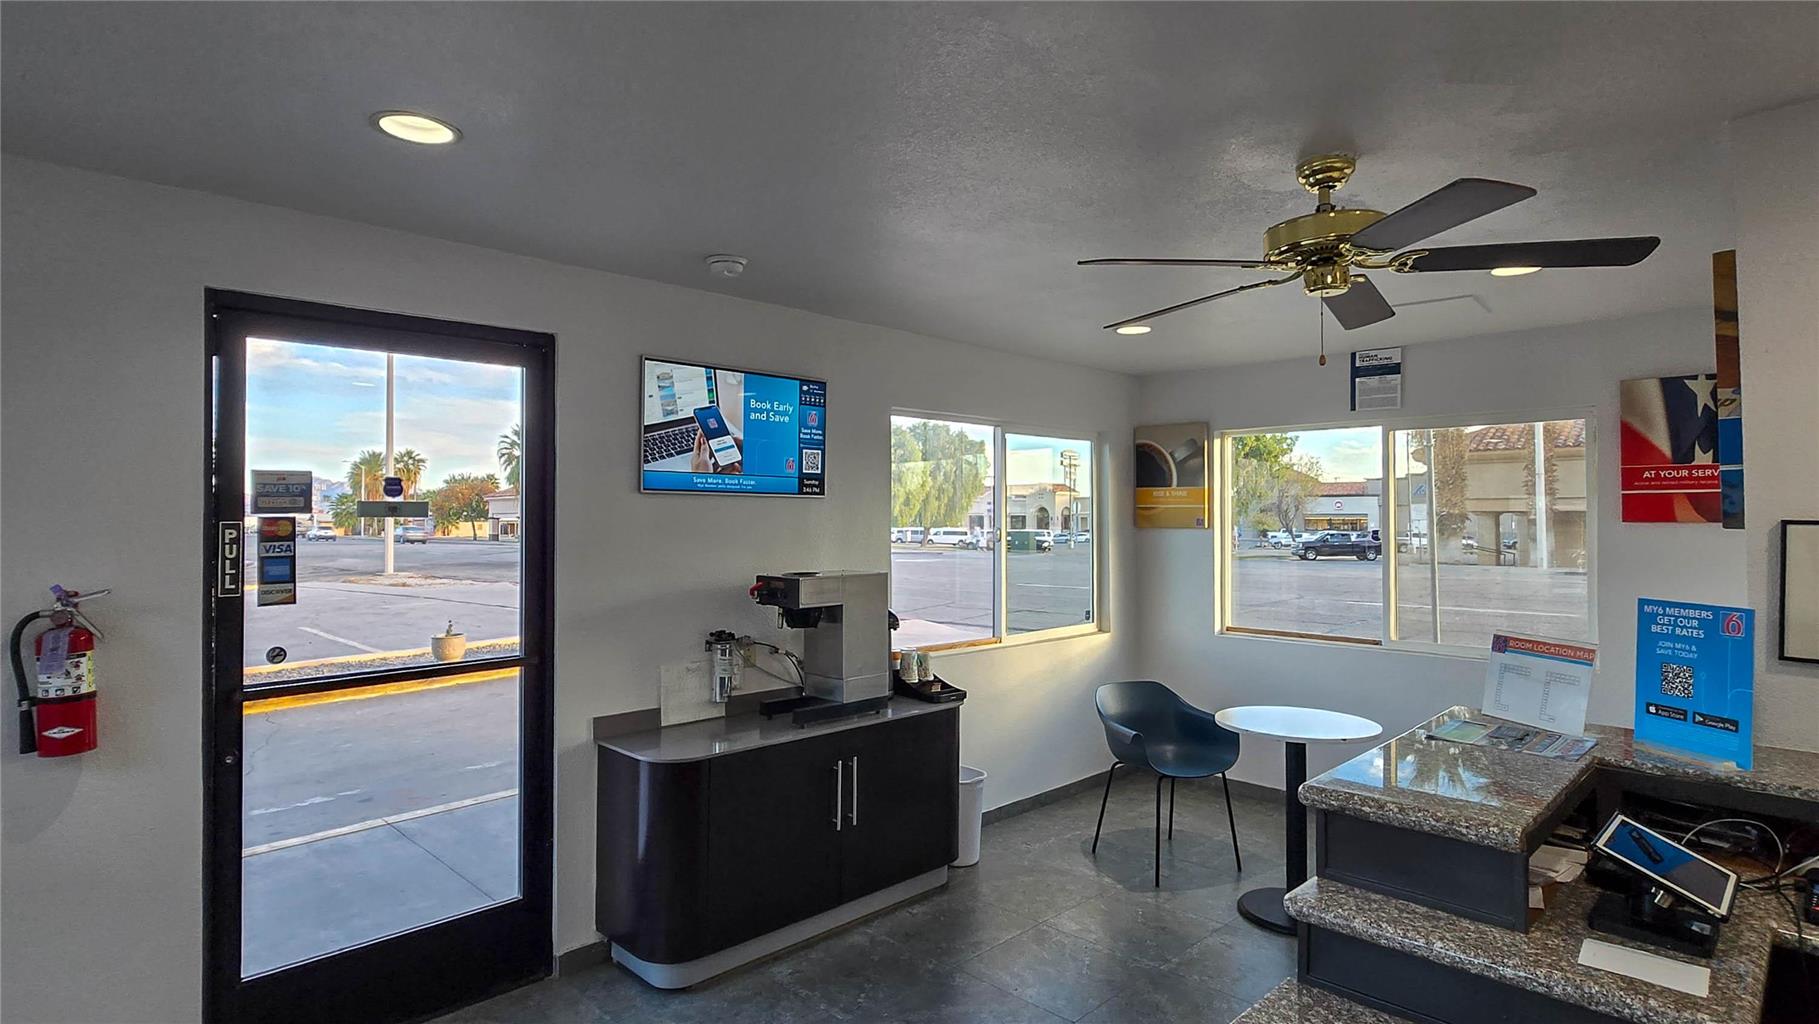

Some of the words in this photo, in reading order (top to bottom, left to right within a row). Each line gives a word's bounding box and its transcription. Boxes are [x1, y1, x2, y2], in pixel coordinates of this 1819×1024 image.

[750, 399, 772, 409] Book
[773, 401, 794, 415] Early
[750, 411, 767, 420] and
[769, 412, 790, 423] Save
[1643, 470, 1656, 478] AT
[1659, 469, 1689, 478] YOUR
[256, 484, 287, 493] SAVE
[263, 543, 293, 554] VISA
[224, 529, 238, 589] PULL
[1644, 604, 1664, 614] MY6
[1665, 607, 1714, 619] MEMBERS
[1656, 615, 1676, 625] GET
[1677, 617, 1699, 628] OUR
[1724, 611, 1743, 637] 6
[1651, 624, 1674, 634] BEST
[1675, 627, 1705, 639] RATES
[1509, 640, 1533, 650] ROOM
[1533, 643, 1575, 657] LOCATION
[1575, 650, 1595, 660] MAP
[1657, 640, 1674, 649] JOIN
[1690, 644, 1697, 652] &
[1656, 647, 1673, 656] SAVE
[1674, 650, 1698, 659] TODAY
[1705, 719, 1725, 728] Google
[1724, 722, 1737, 731] Play
